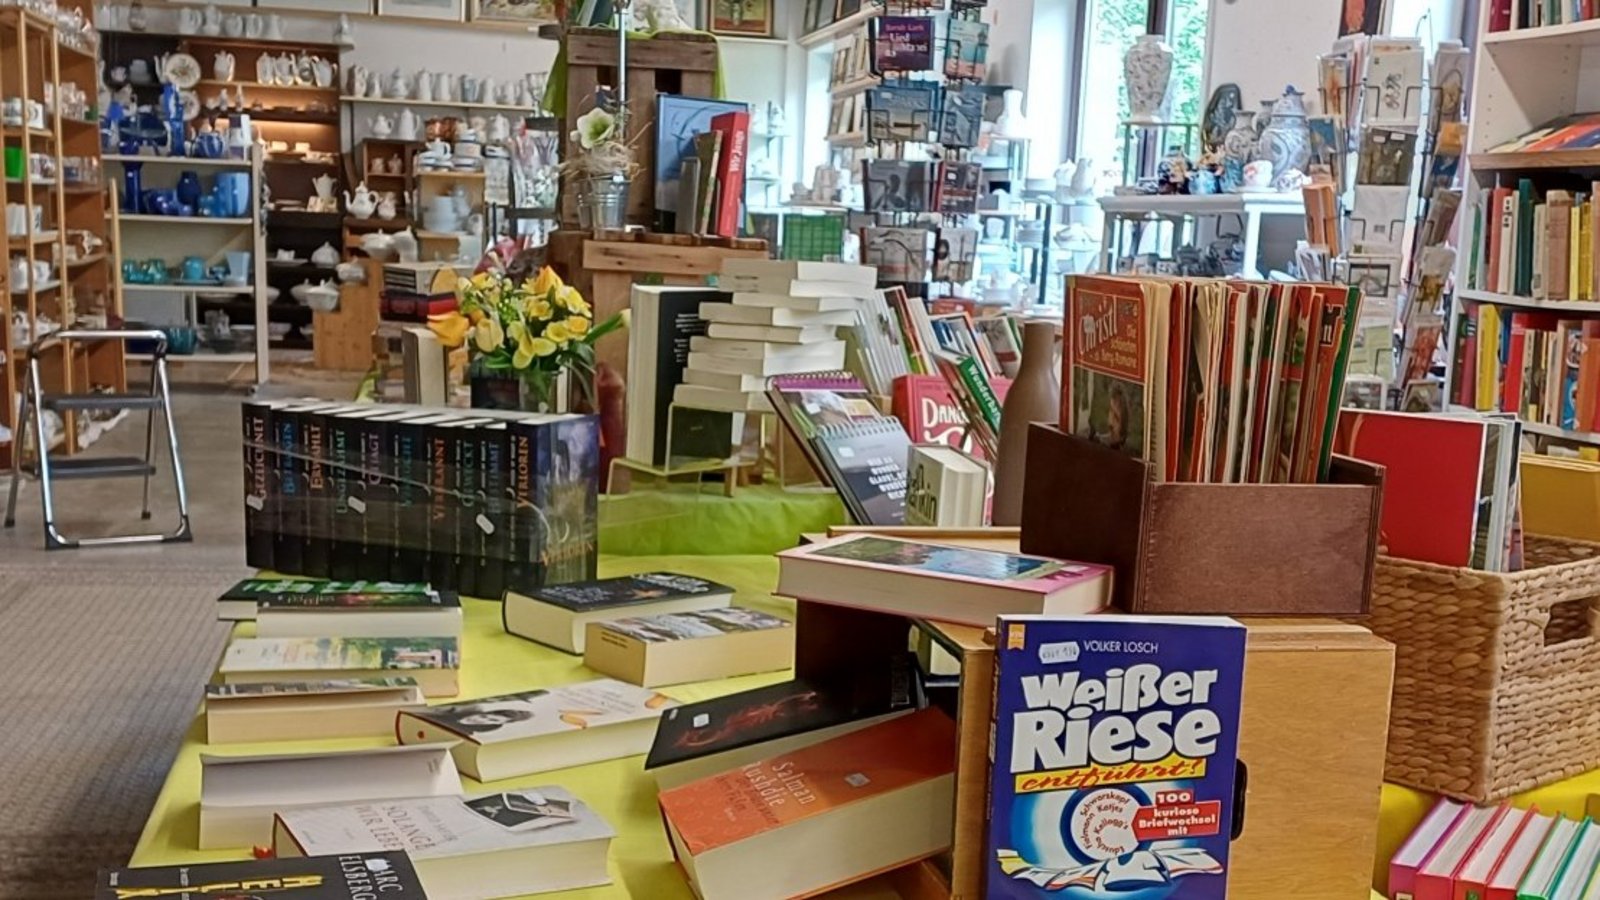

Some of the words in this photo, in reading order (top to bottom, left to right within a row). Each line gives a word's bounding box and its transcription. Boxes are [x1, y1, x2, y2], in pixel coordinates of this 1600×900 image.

[1083, 640, 1121, 653] VOLKER
[1123, 641, 1159, 654] LOSCH
[1020, 663, 1219, 713] Weißer
[1011, 706, 1221, 774] Riese
[771, 760, 816, 806] Salman
[1157, 792, 1191, 804] 100
[1153, 806, 1200, 818] kuriose
[1138, 815, 1216, 829] Briefwechsel
[1167, 827, 1188, 836] mit
[338, 855, 378, 900] ELSBERG
